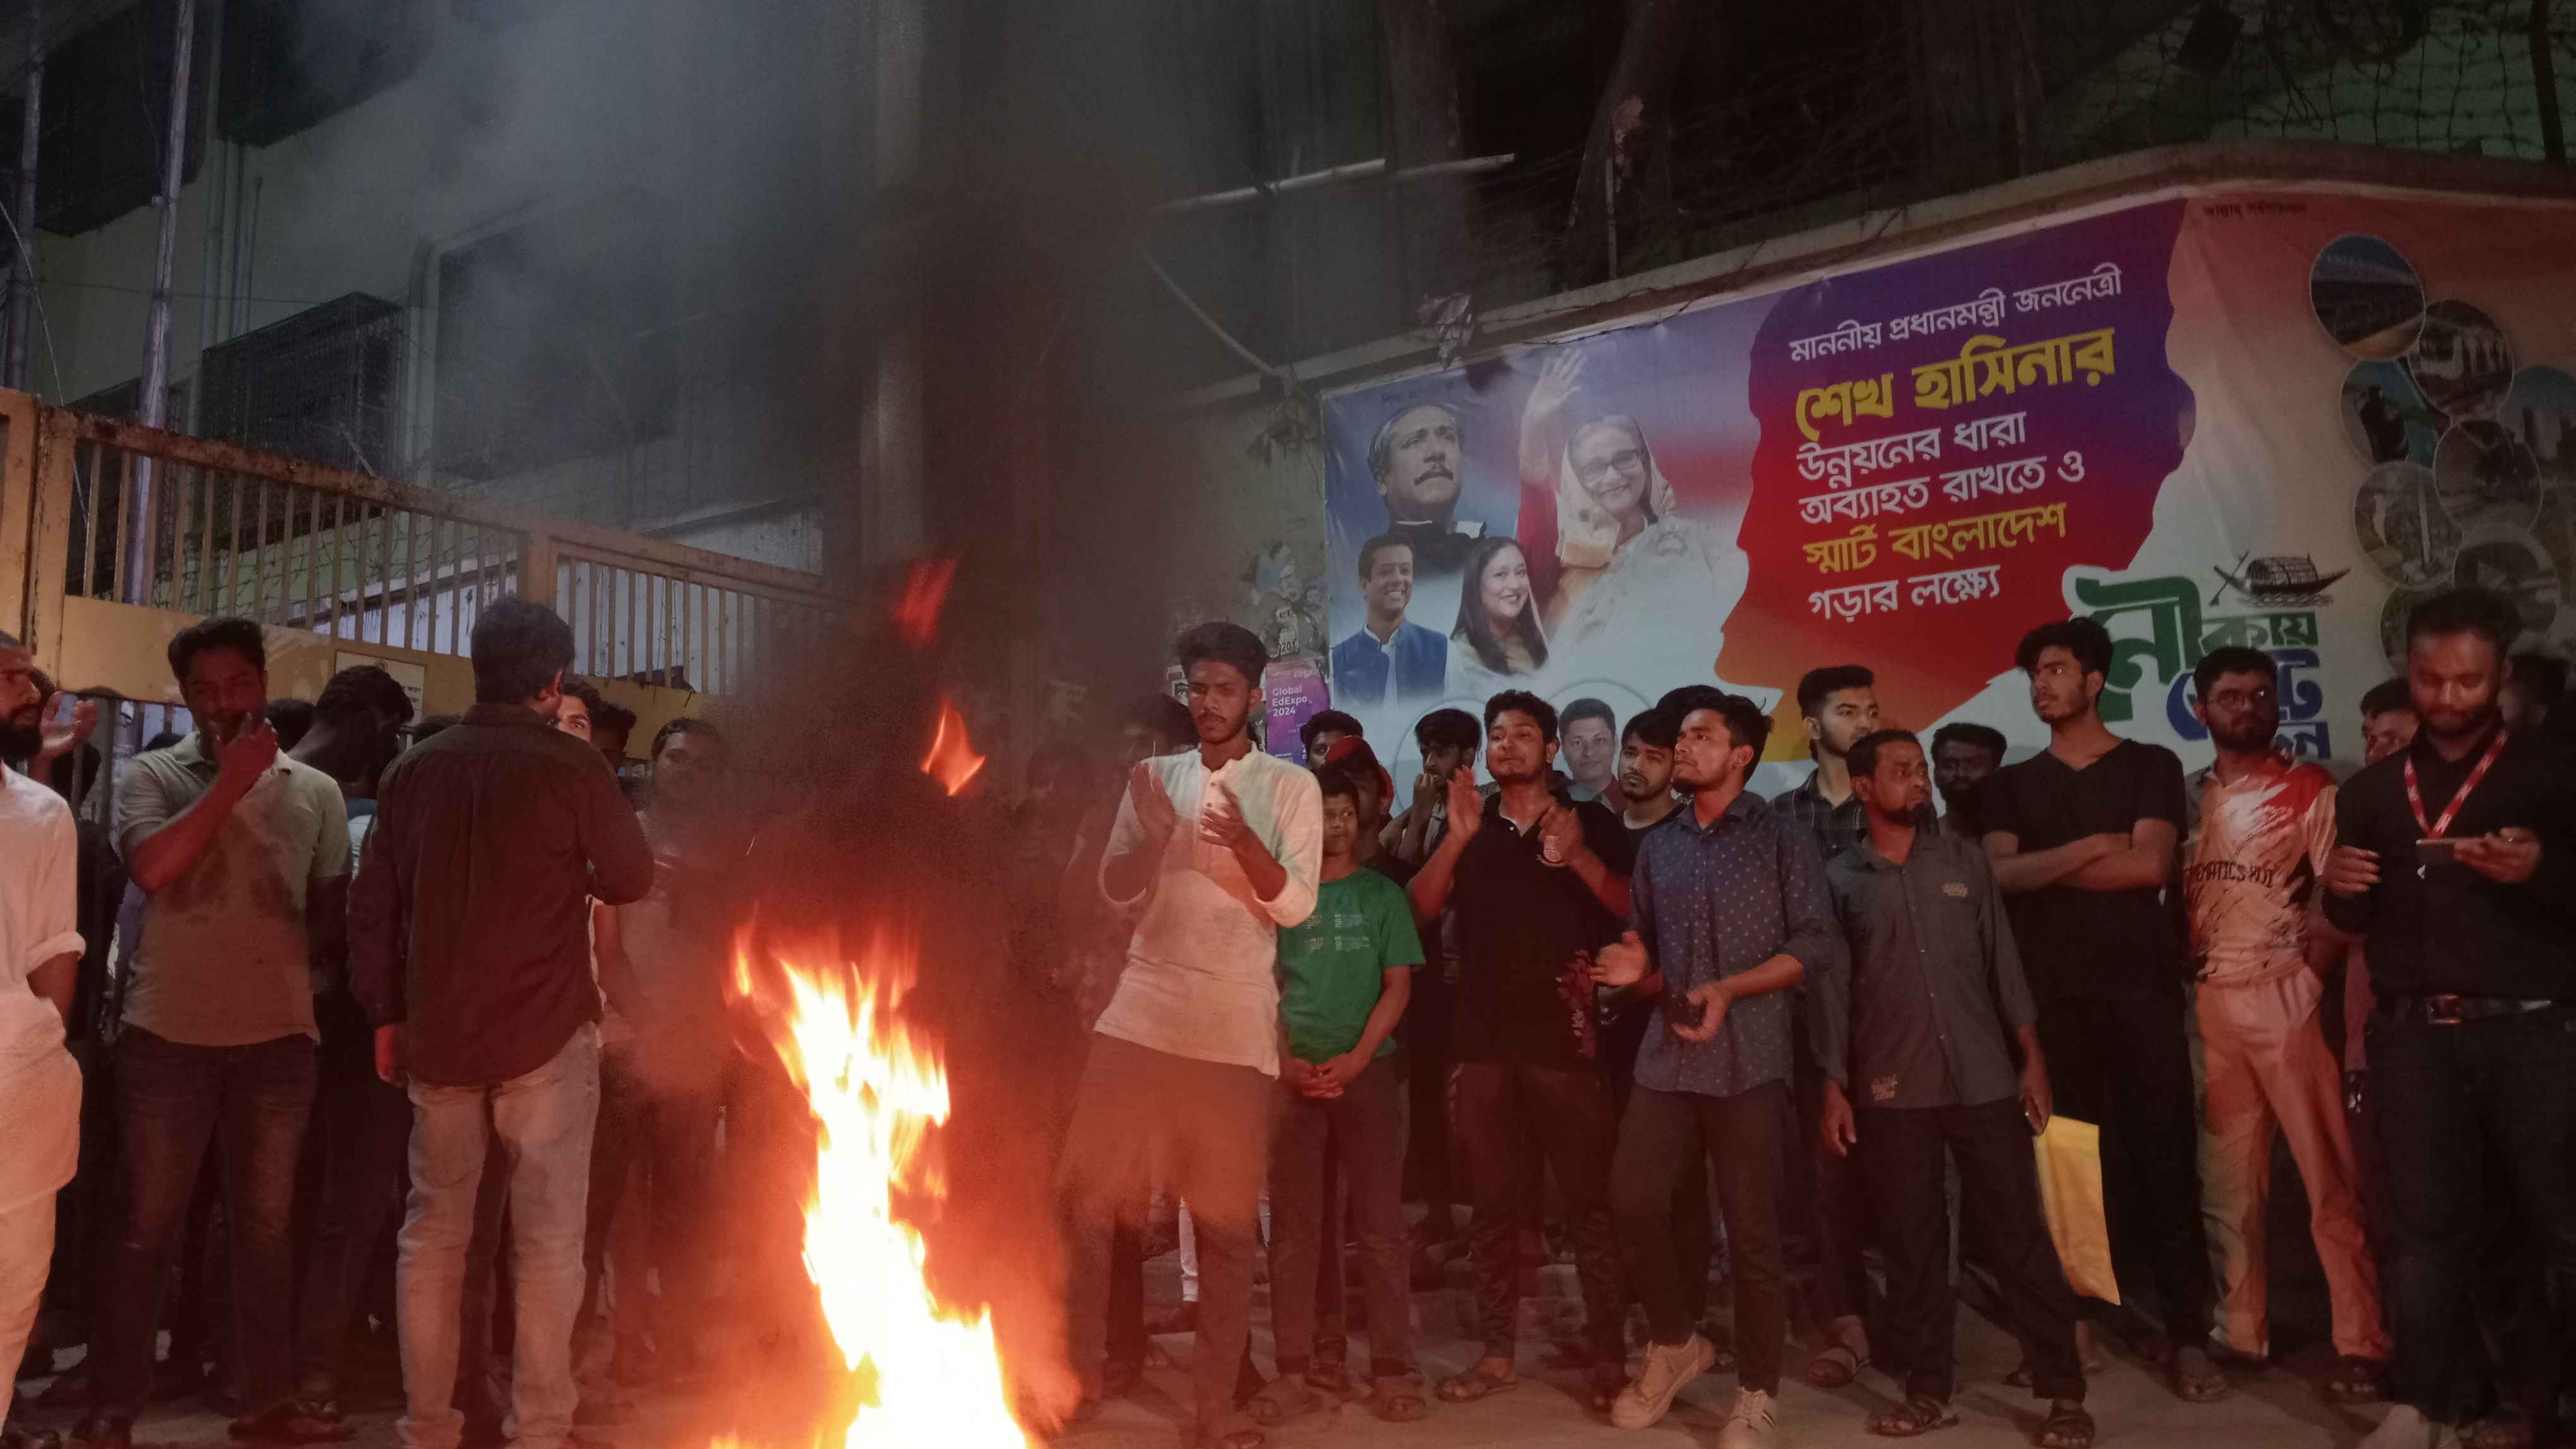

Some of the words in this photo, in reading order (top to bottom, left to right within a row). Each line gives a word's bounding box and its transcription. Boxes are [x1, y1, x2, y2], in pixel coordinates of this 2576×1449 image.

[1789, 320, 1882, 362] মাননীয়
[1889, 287, 2006, 340] প্রধানমন্ত্রী
[2013, 262, 2121, 312] জননেত্রী
[1796, 373, 1894, 441] শেখ
[1911, 327, 2115, 409] হাসিনার
[1796, 427, 1941, 489] উন্নয়নের
[1953, 411, 2027, 451] ধারা
[1798, 476, 1931, 524] অব্যাহত
[1941, 455, 2047, 502] রাখতে
[2057, 451, 2085, 482] ও
[1802, 523, 1878, 573] স্মার্ট
[1888, 502, 2066, 559] বাংলাদেশ
[1808, 580, 1899, 623] গড়ার
[1907, 564, 2000, 606] লক্ষ্যে
[1272, 686, 1302, 696] Global
[1272, 696, 1308, 707] EdExpo
[1272, 707, 1296, 717] 2024
